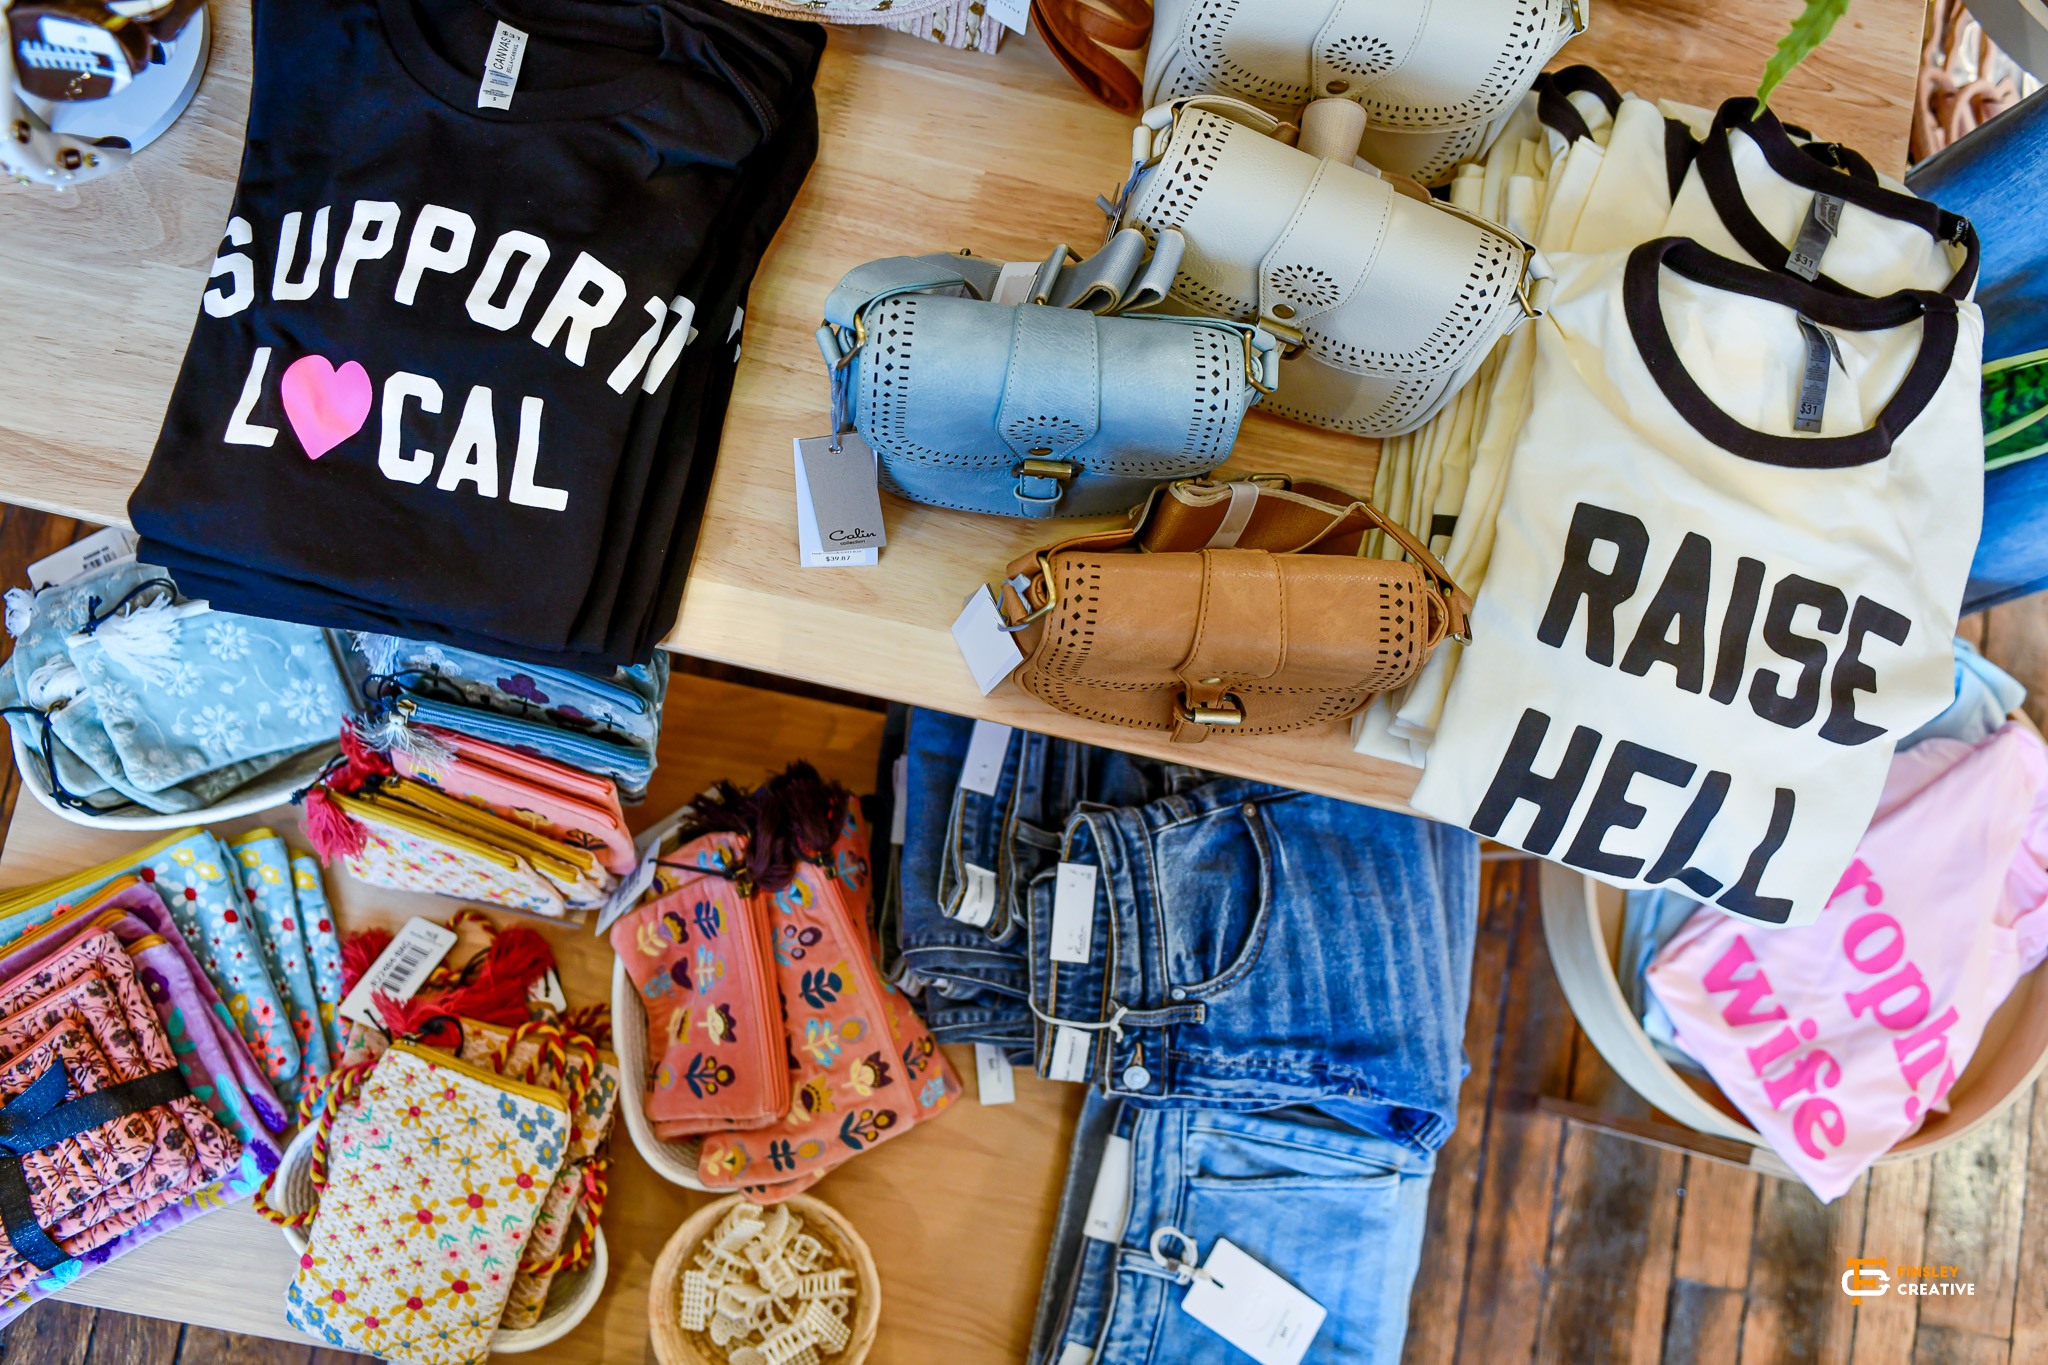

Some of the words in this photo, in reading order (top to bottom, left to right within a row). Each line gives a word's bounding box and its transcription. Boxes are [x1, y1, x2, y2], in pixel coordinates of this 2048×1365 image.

[493, 37, 511, 70] CANVAS
[204, 200, 668, 395] SUPPORT
[1794, 253, 1814, 268] $31
[1800, 402, 1817, 416] $31
[829, 527, 876, 541] Calin
[1537, 502, 1911, 746] RAISE
[1469, 707, 1796, 924] HELL
[1702, 934, 1846, 1160] wife
